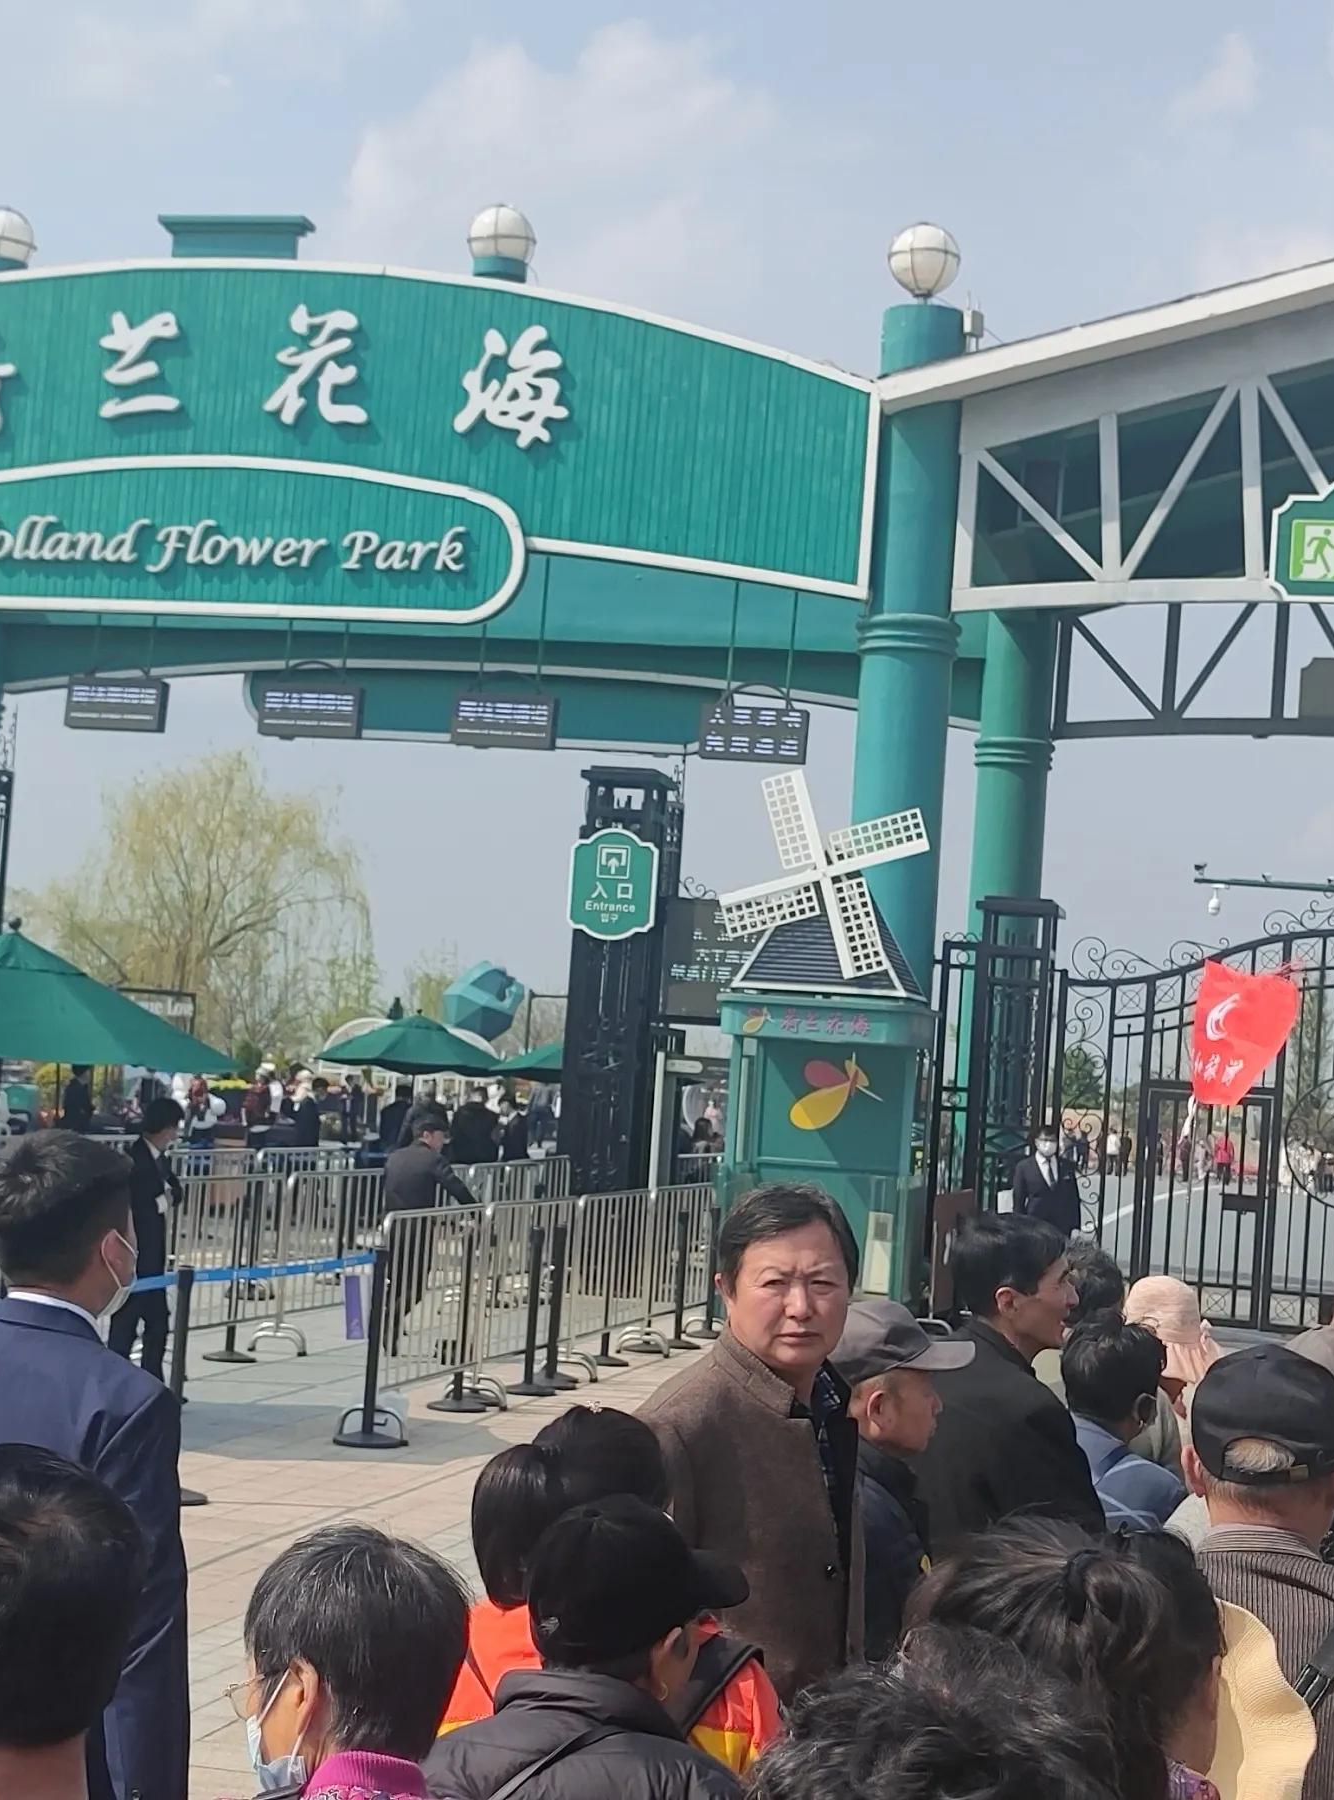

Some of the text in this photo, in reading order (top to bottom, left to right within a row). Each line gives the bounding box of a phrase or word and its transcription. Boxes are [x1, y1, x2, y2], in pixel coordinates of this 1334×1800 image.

[146, 519, 327, 573] Flower
[340, 525, 466, 572] Park
[590, 881, 634, 900] 入口
[584, 900, 636, 913] Entrance
